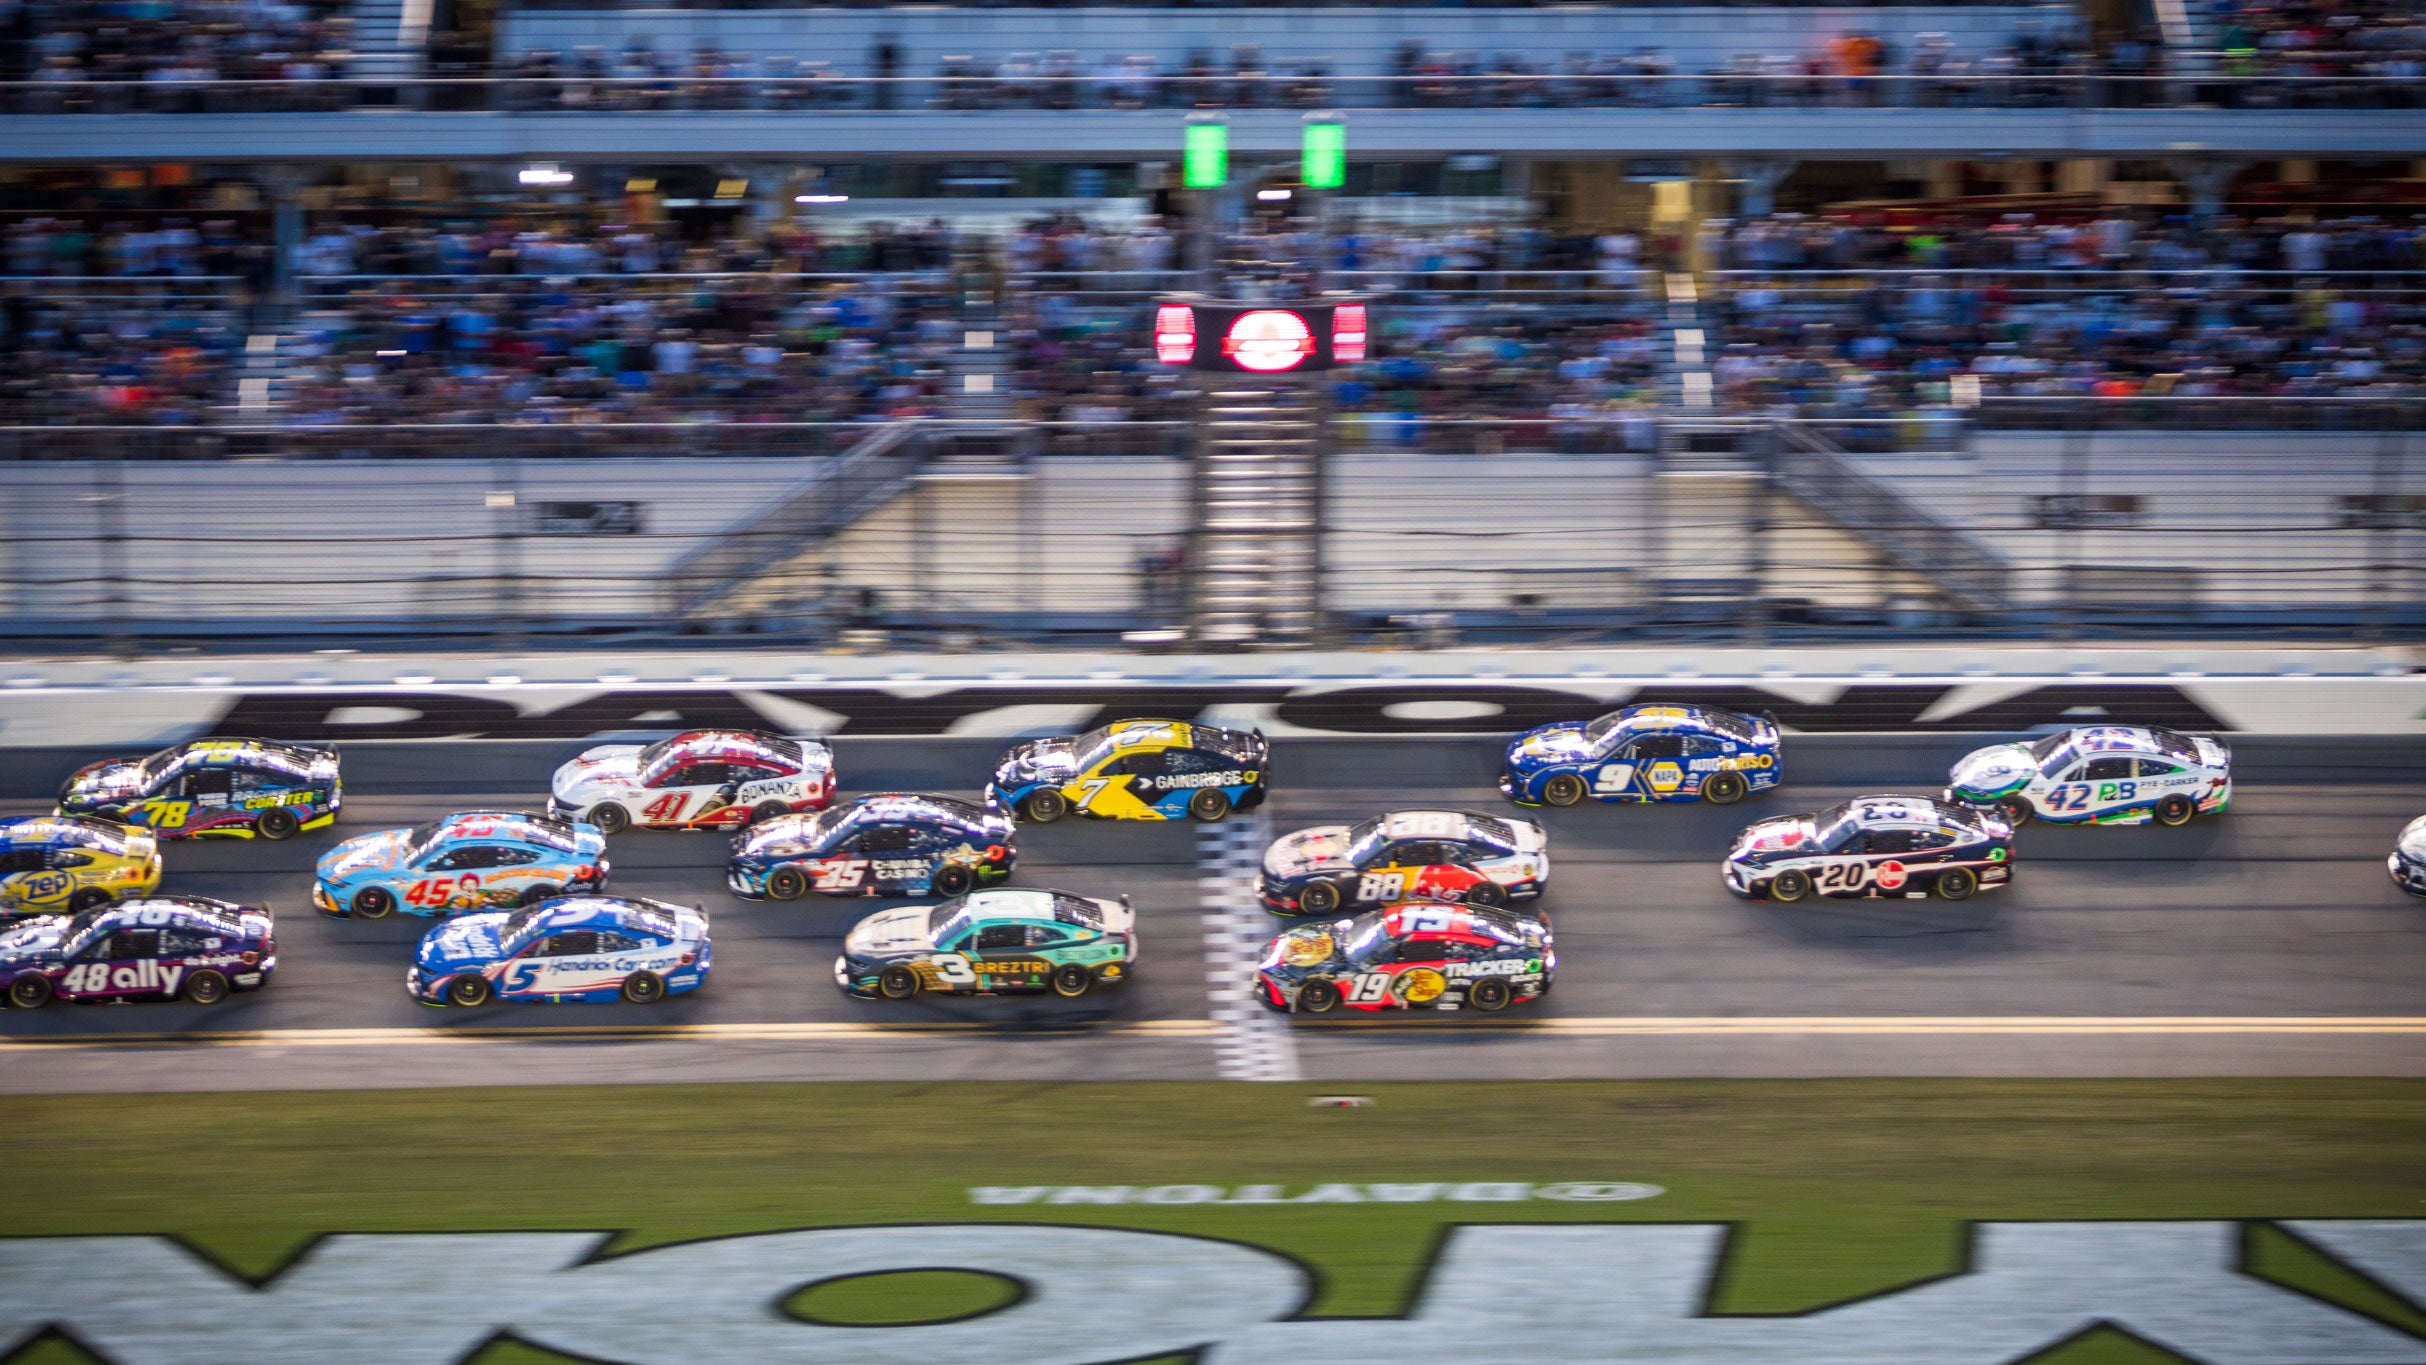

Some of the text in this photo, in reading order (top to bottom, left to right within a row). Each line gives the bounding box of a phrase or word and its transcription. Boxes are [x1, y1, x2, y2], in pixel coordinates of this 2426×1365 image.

[205, 684, 2234, 738] DAYTONA
[1654, 770, 1678, 782] NAPA
[1720, 756, 1760, 770] PRTS
[1155, 769, 1242, 788] GAINBRIDGE
[1594, 764, 1634, 791] 9
[245, 792, 313, 810] COATER
[742, 781, 801, 803] BONANZA
[1076, 779, 1109, 809] 7
[2045, 784, 2093, 811] 42
[143, 801, 191, 828] 78
[643, 791, 692, 821] 41
[815, 860, 868, 888] 35
[871, 859, 932, 870] CHUMBA
[875, 868, 929, 880] CASINO
[1823, 863, 1866, 888] 20
[404, 879, 453, 905] 45
[1357, 873, 1404, 901] 88
[63, 960, 183, 997] 48 ally
[504, 964, 540, 992] 5
[931, 954, 975, 982] 3
[974, 961, 1049, 974] BREZTRI
[1447, 959, 1525, 977] TRACKER
[1348, 973, 1391, 1001] 19
